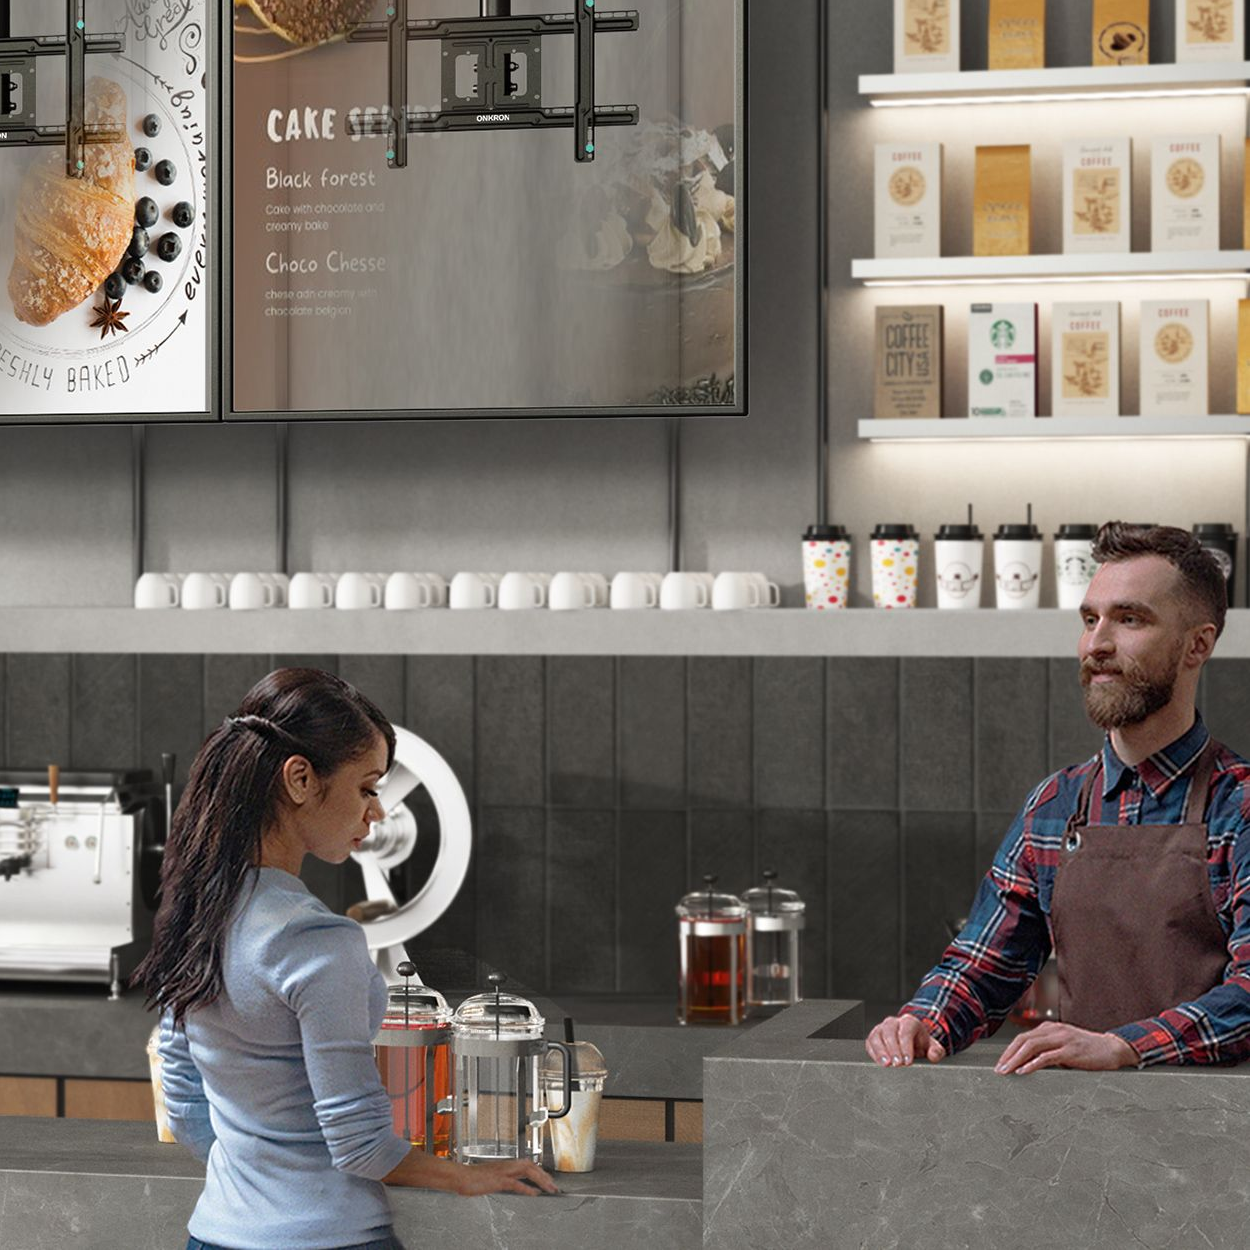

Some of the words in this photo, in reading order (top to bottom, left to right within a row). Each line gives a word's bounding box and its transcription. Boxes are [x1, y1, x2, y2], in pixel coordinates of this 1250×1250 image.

[266, 106, 337, 143] CAKE
[476, 113, 511, 123] ONKRON
[1169, 142, 1201, 153] COFFEE
[1080, 157, 1112, 167] COFFEE
[266, 166, 312, 189] Black
[320, 167, 377, 188] forest
[265, 203, 291, 216] Cake
[292, 203, 313, 215] with
[314, 201, 363, 214] chocolate
[364, 201, 385, 213] and
[265, 221, 302, 233] creamy
[265, 251, 318, 274] Choco
[326, 250, 387, 273] Chesse
[1158, 308, 1190, 318] COFFEE
[1069, 320, 1101, 331] COFFEE
[885, 323, 929, 350] COFFEE
[885, 351, 915, 377] CITY
[67, 354, 130, 393] BAKED
